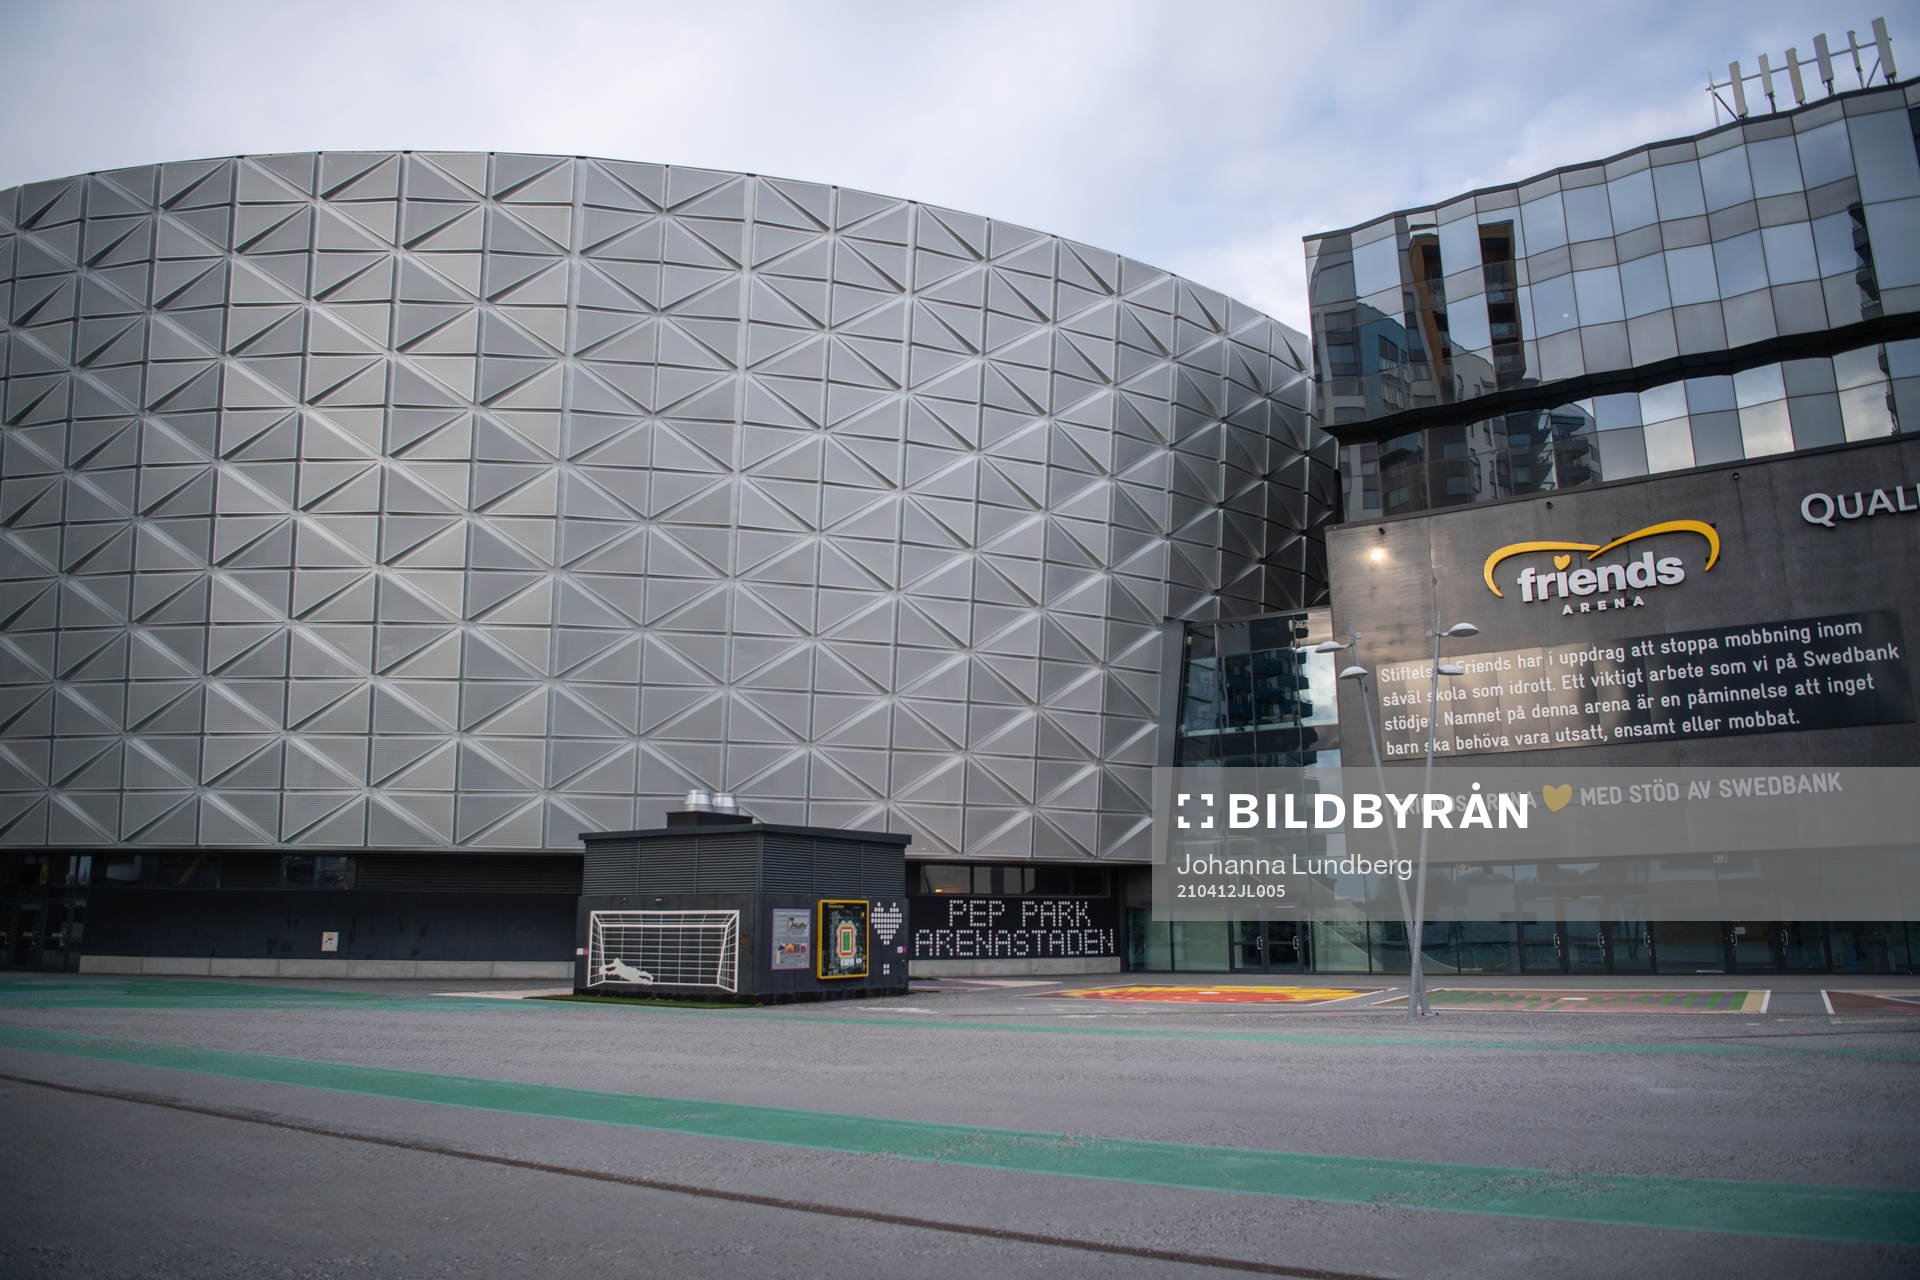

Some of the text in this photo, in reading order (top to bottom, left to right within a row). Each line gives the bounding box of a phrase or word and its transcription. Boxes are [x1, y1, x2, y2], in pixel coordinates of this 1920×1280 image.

[1517, 552, 1685, 602] friends
[1562, 596, 1645, 615] ARENA
[1381, 622, 1863, 682] Stiftels Friends har i uppdrag att stoppa mobbning inom
[1383, 643, 1900, 706] såväl skola som idrott. Ett viktigt arbete som vi på Swedbank
[1384, 673, 1875, 732] stödje. Namnet på denna arena är en påminnelse att inget
[1387, 708, 1800, 755] barn ska behöva vara utsatt, ensamt eller mobbat.
[1580, 786, 1622, 806] MED
[1629, 779, 1680, 804] STÖD
[1687, 780, 1711, 800] AV
[1719, 772, 1843, 799] SWEDBANK
[949, 900, 1091, 927] PEP PARK
[915, 929, 1114, 956] ARENASTADEN
